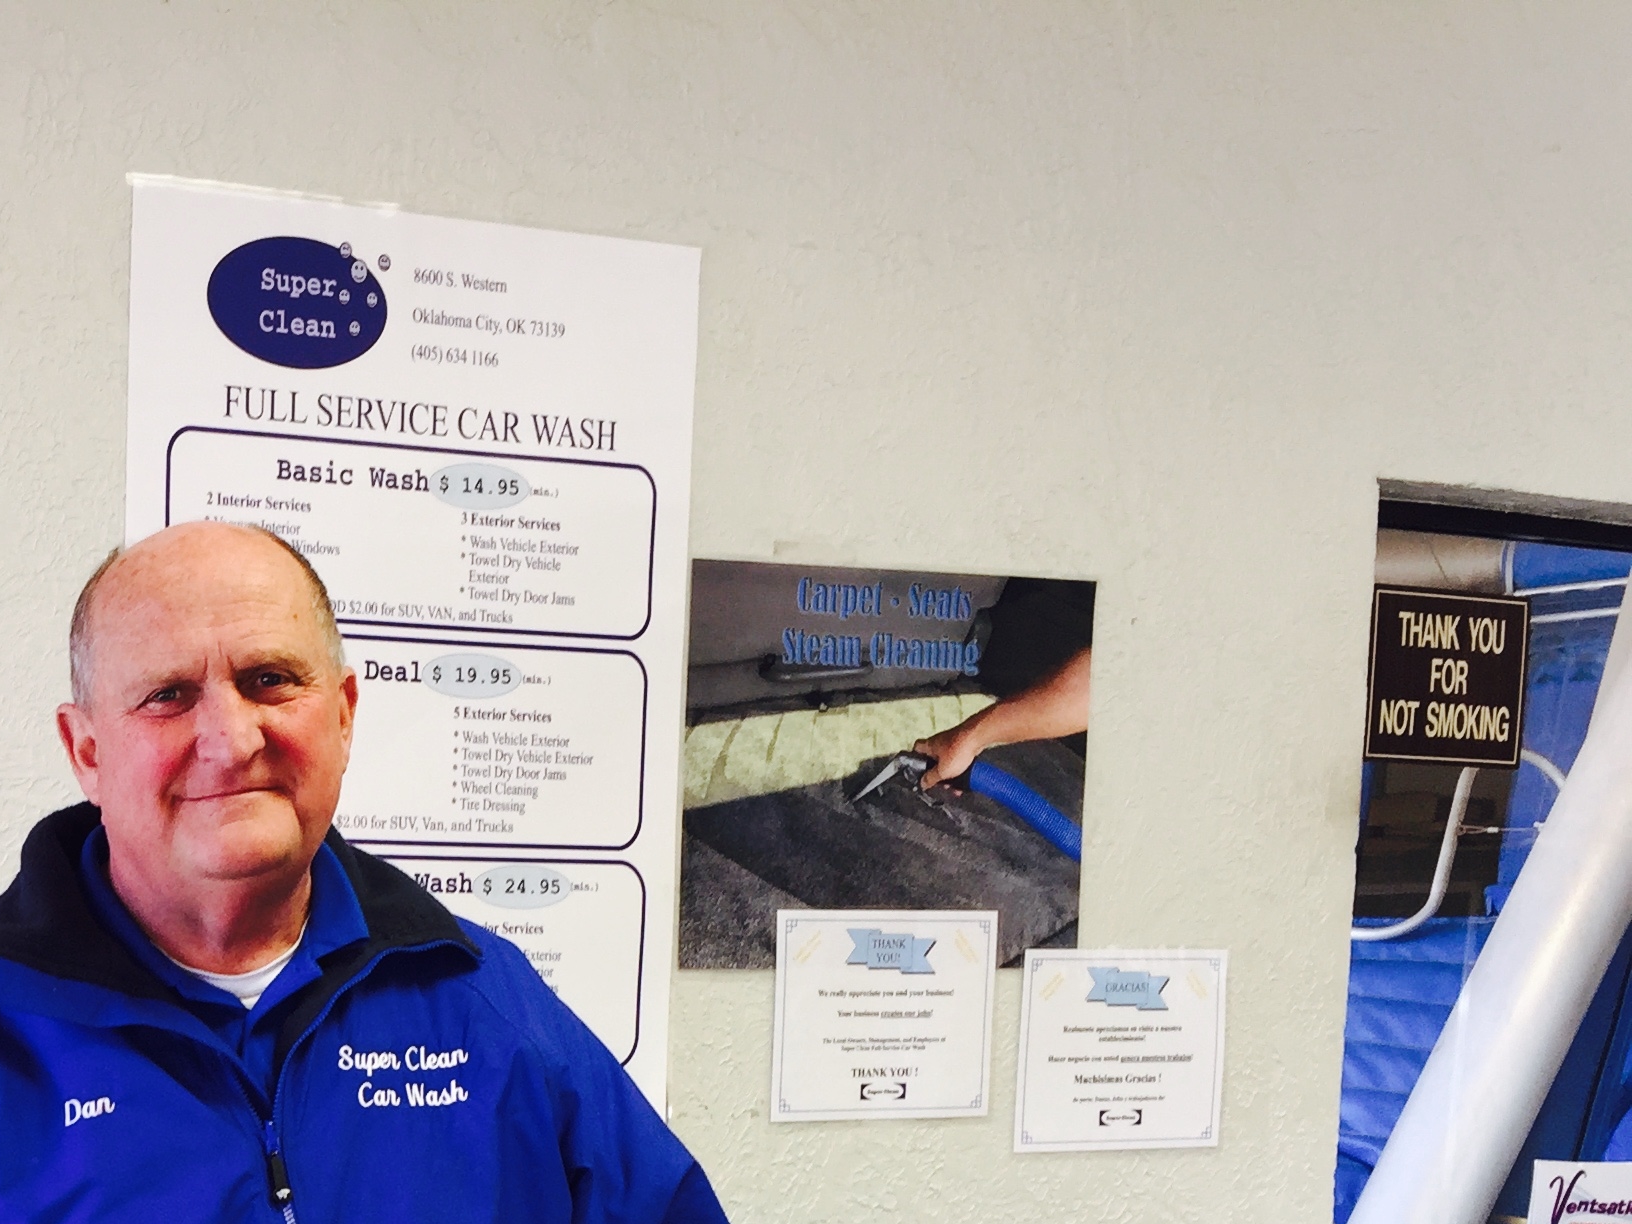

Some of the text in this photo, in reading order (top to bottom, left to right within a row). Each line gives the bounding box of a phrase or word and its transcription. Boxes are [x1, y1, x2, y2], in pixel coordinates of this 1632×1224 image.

[261, 267, 337, 299] Super
[412, 267, 508, 294] 8600 S. Western
[259, 309, 336, 340] Clean
[412, 307, 566, 339] Oklahoma City, OK 73139
[411, 344, 500, 368] (405) 634 1166
[224, 384, 618, 453] FULL SERVICE CAR WASH
[277, 458, 560, 499] Basic Wash $ 14.95 (min.)
[206, 491, 312, 514] 2 Interior Services
[461, 511, 561, 532] 3 Exterior Services
[291, 539, 341, 556] Windows
[470, 535, 580, 557] Wash Vehicle Exterior
[469, 552, 562, 572] Towel Dry Vehicle
[468, 569, 510, 586] Exterior
[468, 586, 576, 607] Towel Dry Door Jams
[796, 576, 973, 622] Carpet Seats
[349, 600, 514, 625] $2.00 for SUV, VAN, and Trucks
[1398, 610, 1507, 656] THANK YOU
[781, 627, 981, 677] Steam Cleaning
[364, 660, 552, 686] Deal $ 19.95 (min.)
[1429, 657, 1469, 696] FOR
[453, 706, 553, 724] 5 Exterior Services
[1378, 698, 1511, 743] NOT SMOKING
[462, 730, 571, 748] Wash Vehicle Exterior
[462, 746, 594, 766] Towel Dry Vehicle Exterior
[461, 763, 567, 782] Towel Dry Door Jams
[460, 780, 539, 799] Wheel Cleaning
[460, 797, 526, 816] Tire Dressing
[336, 815, 515, 833] $2.00 for SUV, Van, and Trucks
[414, 872, 600, 897] Wash $ 24.95 (min.)
[501, 921, 545, 936] Services
[872, 938, 907, 950] THANK
[876, 953, 901, 964] YOU!
[338, 1043, 469, 1077] Super Clean
[852, 1067, 913, 1078] THANK YOU
[1125, 1073, 1156, 1083] Gracias
[357, 1079, 469, 1109] Car Wash
[64, 1096, 115, 1128] Dan
